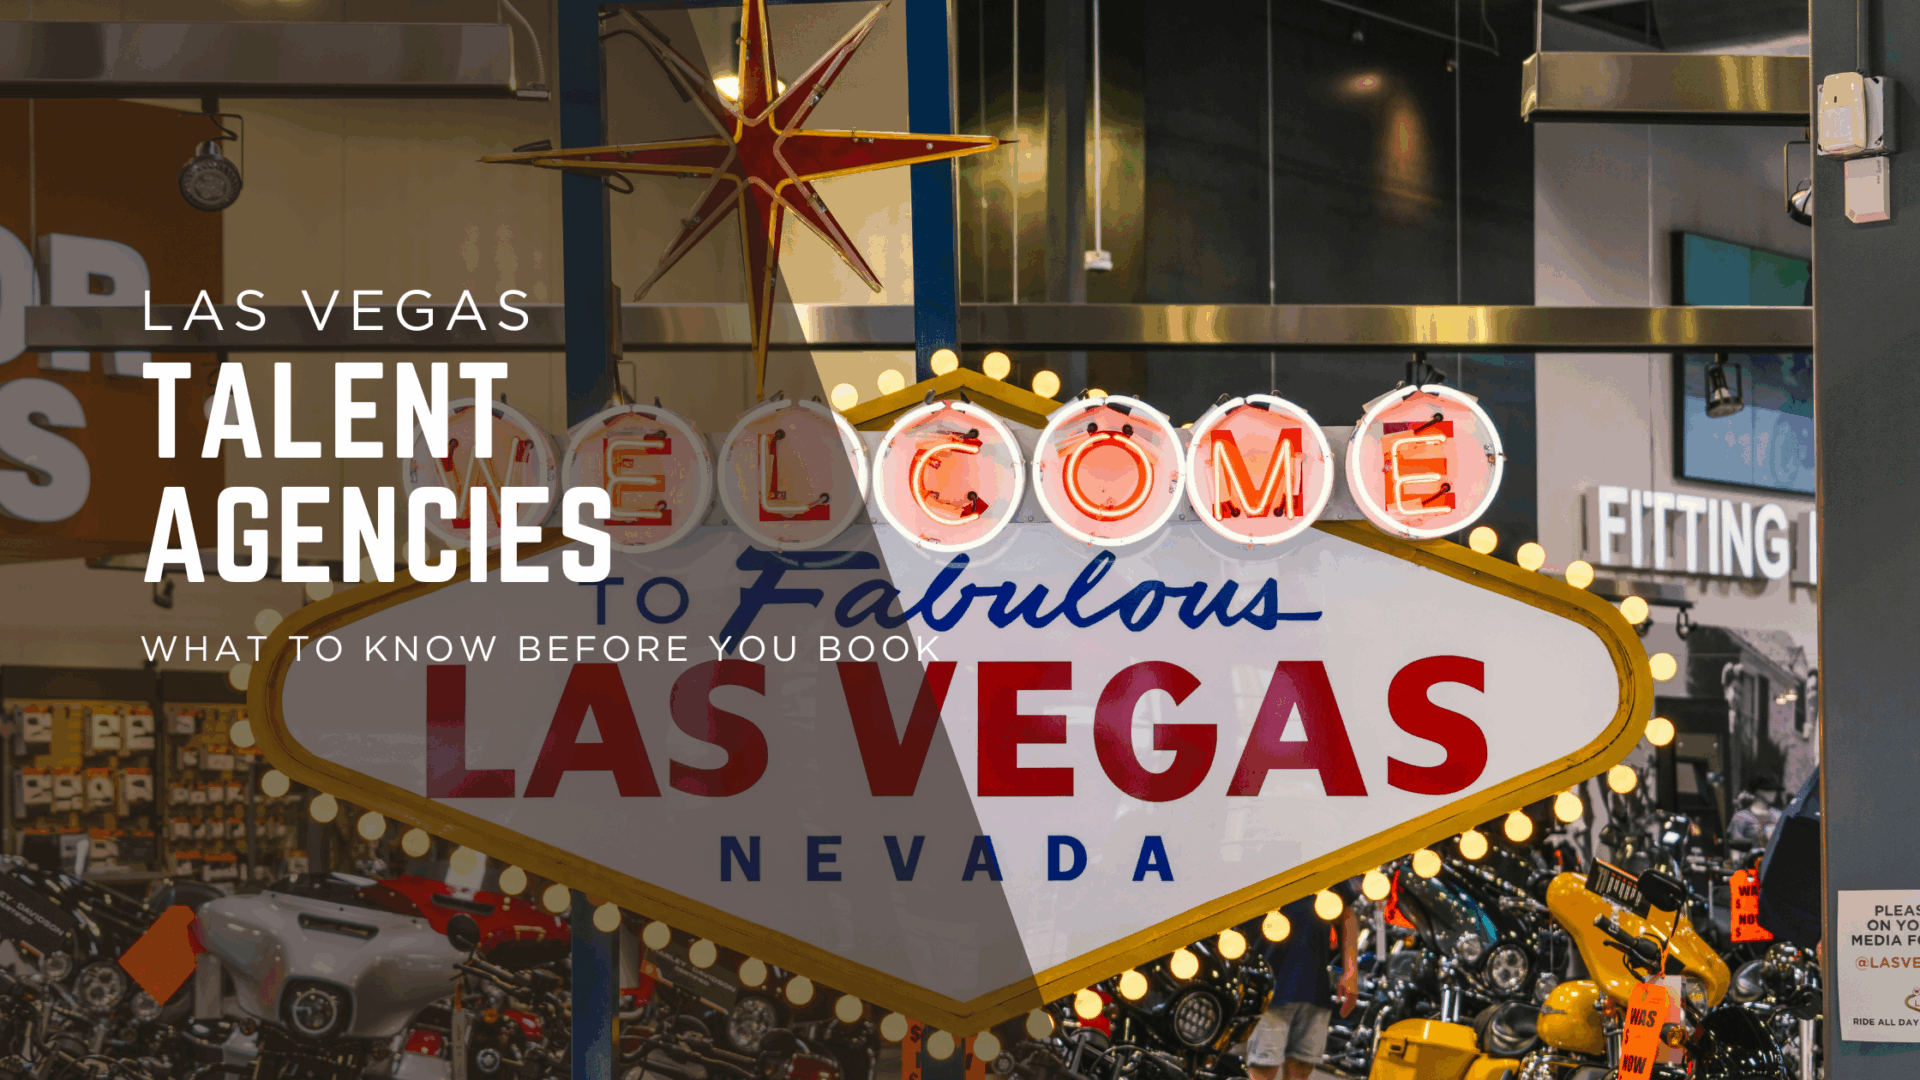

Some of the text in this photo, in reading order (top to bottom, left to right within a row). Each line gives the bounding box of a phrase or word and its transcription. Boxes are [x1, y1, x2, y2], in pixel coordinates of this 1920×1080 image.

[428, 418, 1457, 531] WELCOME
[1598, 485, 1791, 580] FITTING
[579, 545, 1323, 655] TO Fabulous
[426, 655, 1488, 802] LAS VEGAS
[720, 835, 1174, 882] NEVADA
[1739, 886, 1758, 896] WA
[1867, 919, 1920, 931] ON YO
[1851, 934, 1902, 946] MEDIA
[1855, 956, 1920, 971] @LASVE
[1630, 1007, 1658, 1028] WAS
[1853, 1018, 1919, 1026] RIDE ALL DAY
[1621, 1053, 1648, 1075] NOW
